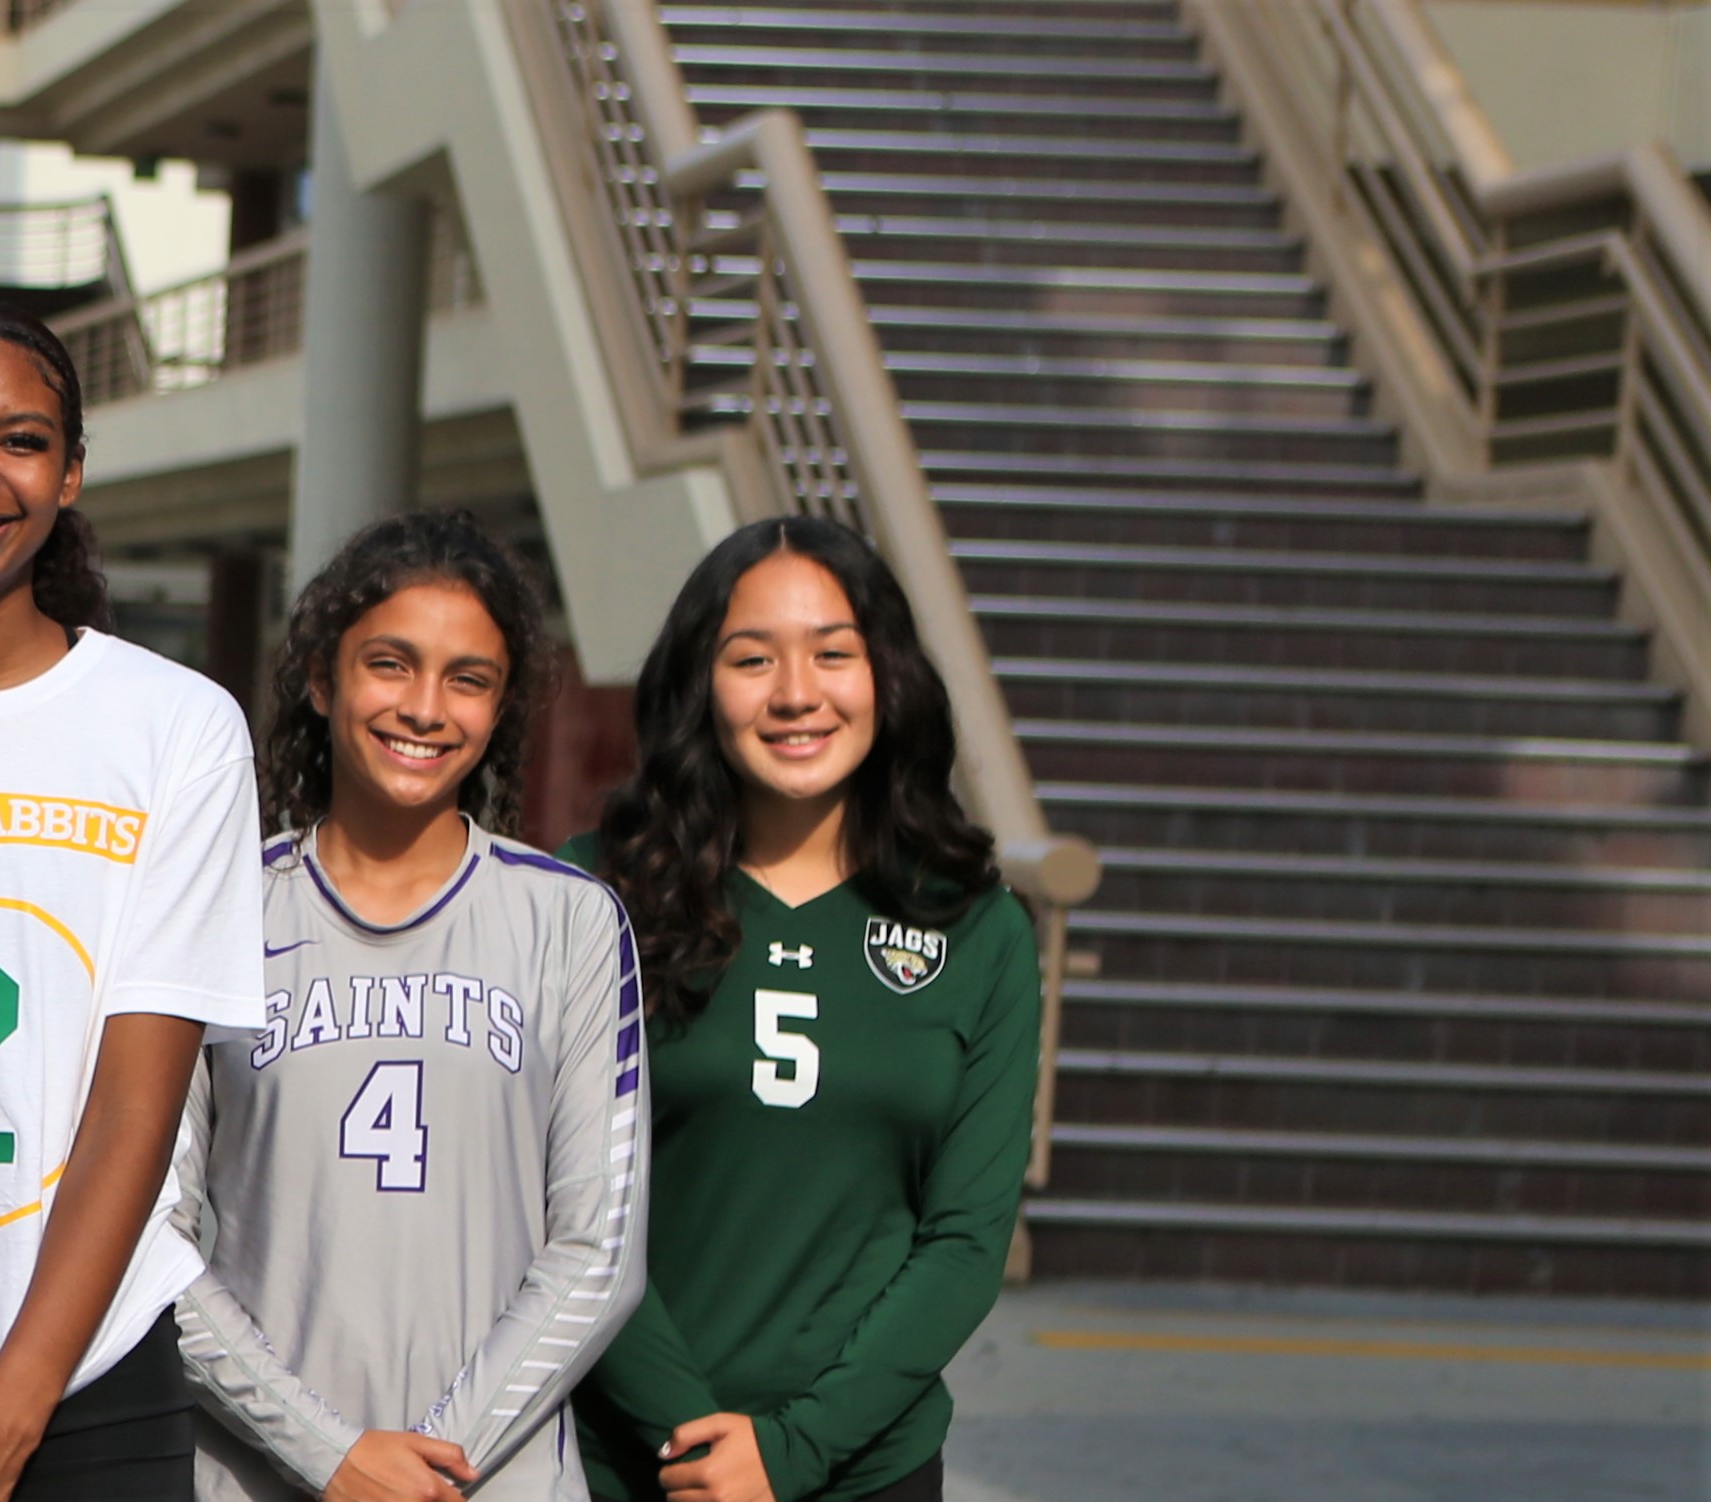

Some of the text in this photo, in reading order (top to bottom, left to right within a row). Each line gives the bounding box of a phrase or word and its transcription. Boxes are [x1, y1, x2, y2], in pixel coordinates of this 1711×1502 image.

[868, 922, 941, 960] JAGS
[250, 973, 524, 1074] SAINTS
[752, 988, 820, 1109] 5
[339, 1060, 428, 1193] 4
